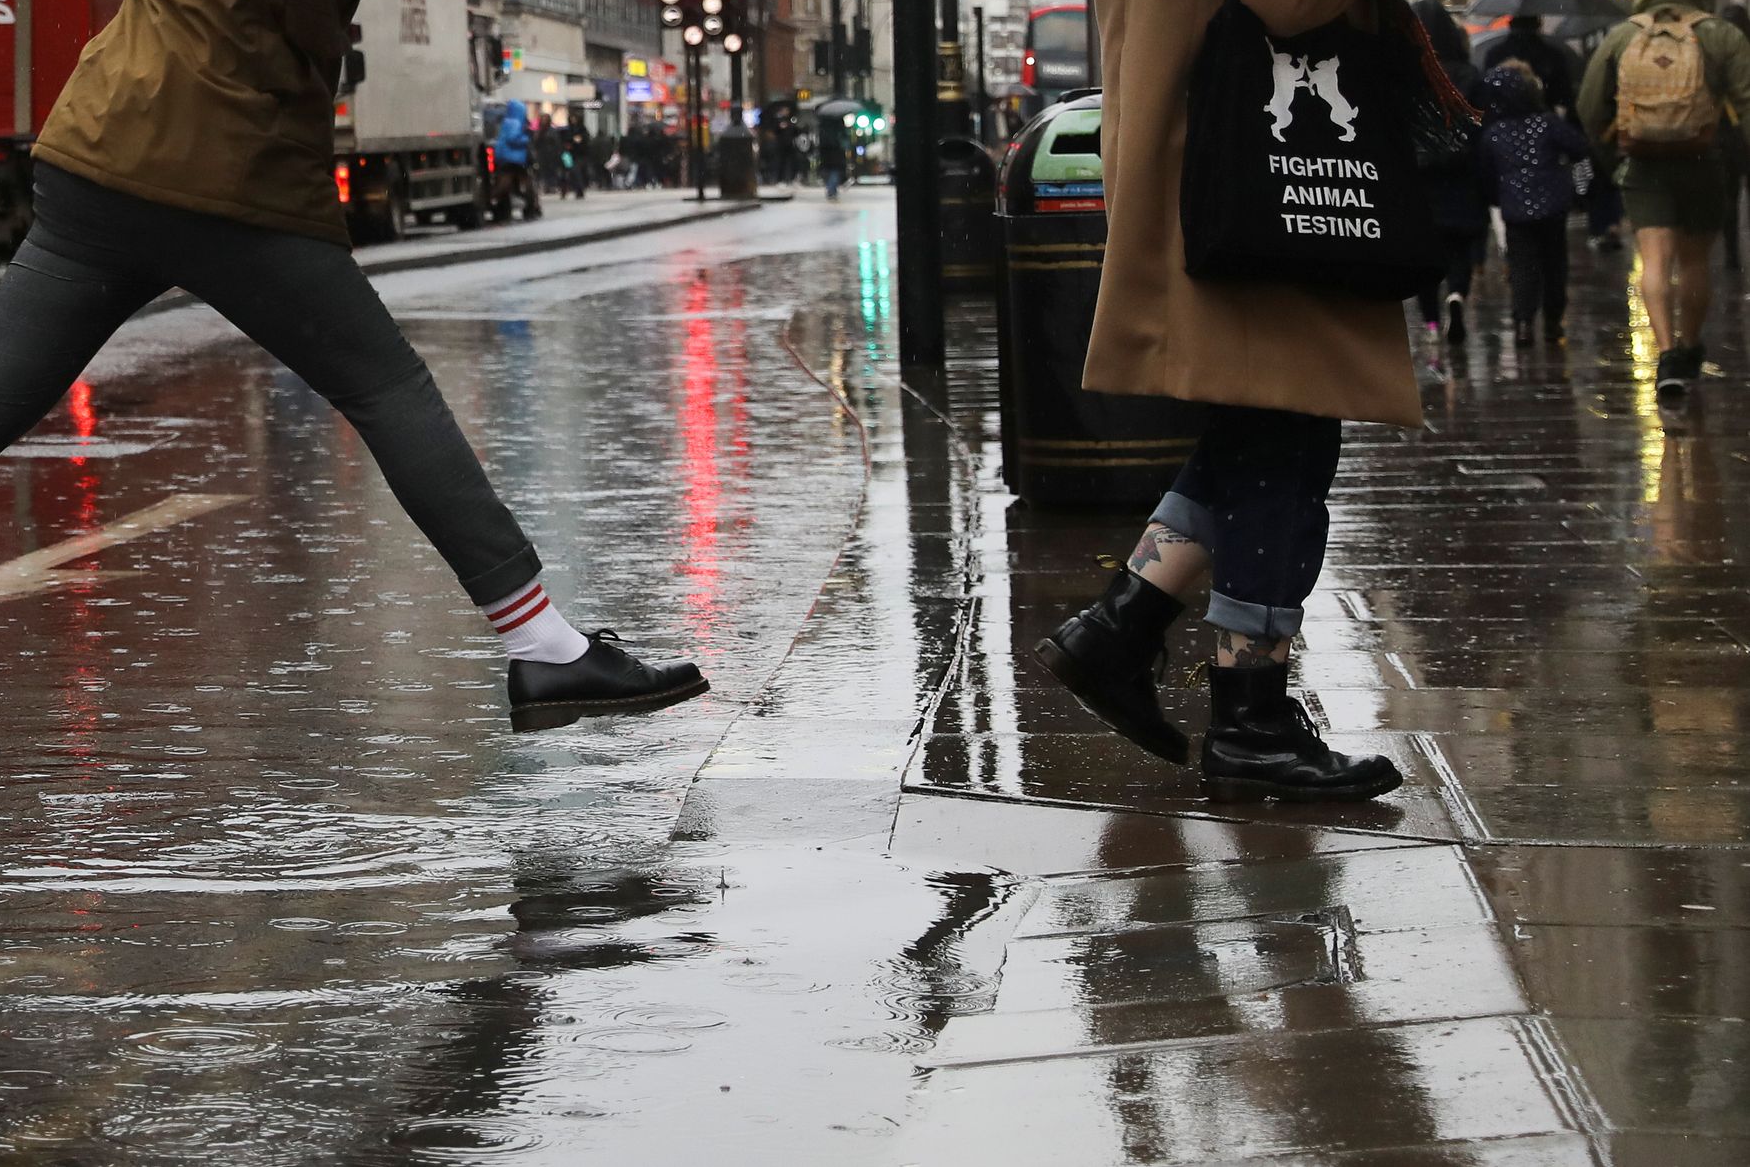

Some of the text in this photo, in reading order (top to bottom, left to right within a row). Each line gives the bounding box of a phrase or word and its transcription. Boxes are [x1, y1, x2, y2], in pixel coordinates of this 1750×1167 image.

[1269, 154, 1379, 181] FIGHTING
[1282, 185, 1374, 208] ANIMAL
[1281, 214, 1381, 239] TESTING
